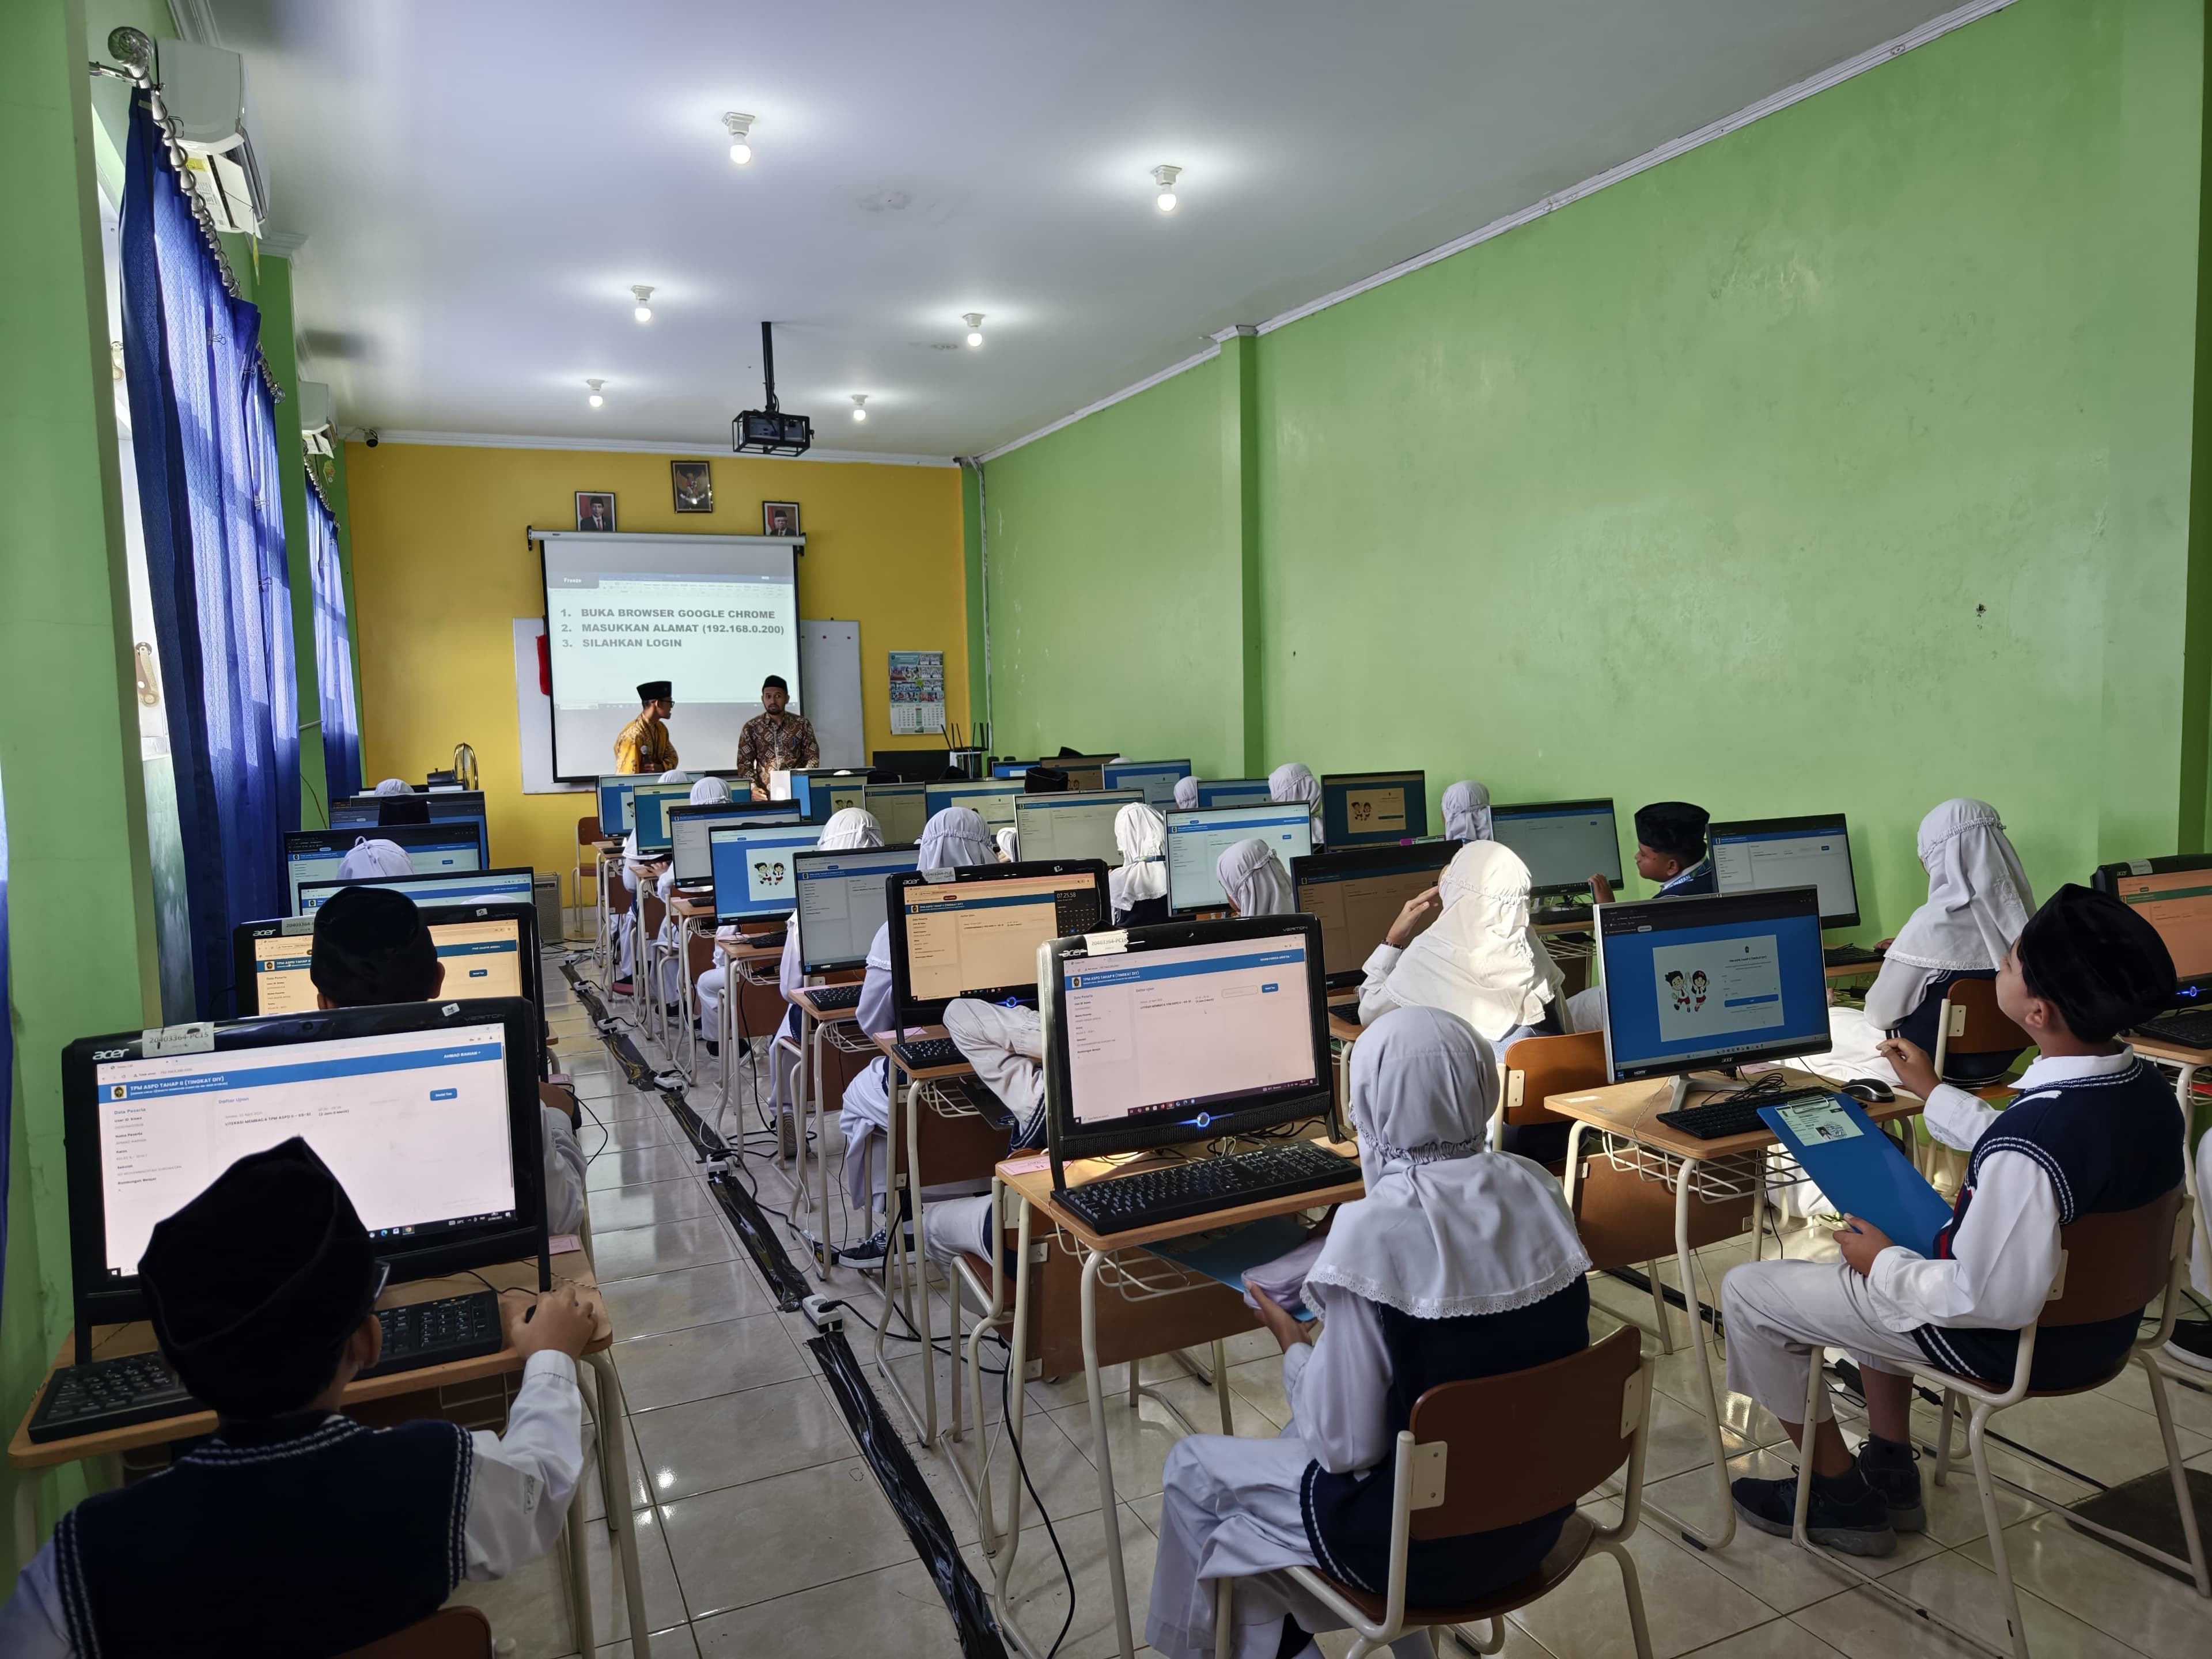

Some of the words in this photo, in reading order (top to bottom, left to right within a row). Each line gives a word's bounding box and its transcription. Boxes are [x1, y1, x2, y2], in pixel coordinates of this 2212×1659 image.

[581, 609, 615, 617] BUKA
[618, 609, 675, 618] BROWSER
[678, 609, 725, 618] GOOGLE
[728, 610, 775, 619] CHROME
[561, 624, 572, 632] 2.
[582, 624, 649, 632] MASUKKAN
[702, 624, 784, 635] (192.168.0.200)
[562, 639, 573, 647] 3.
[583, 639, 643, 647] SILAHKAN
[646, 639, 681, 647] LOGIN
[1062, 949, 1083, 957] acer
[92, 1048, 130, 1060] acer
